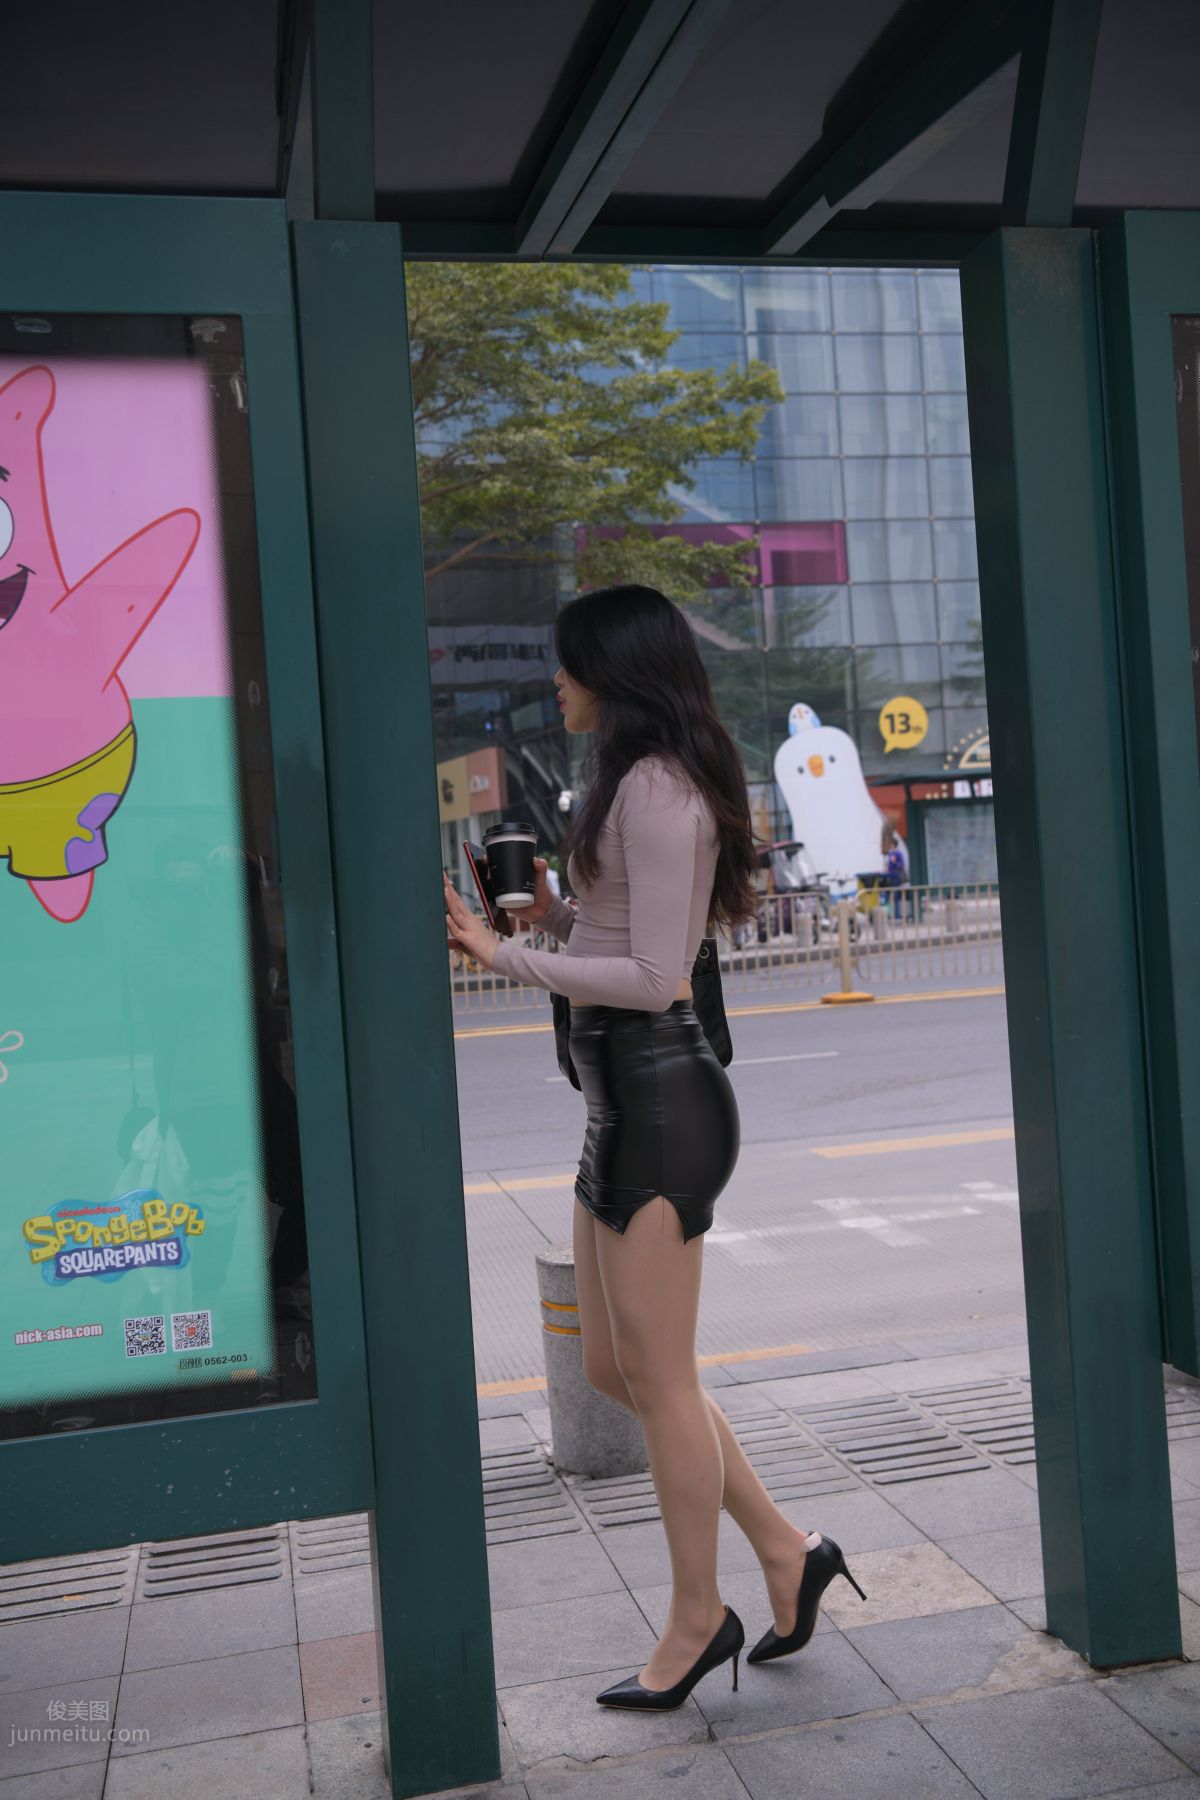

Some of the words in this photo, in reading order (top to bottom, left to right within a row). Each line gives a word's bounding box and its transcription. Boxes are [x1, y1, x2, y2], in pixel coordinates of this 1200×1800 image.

[57, 1205, 121, 1218] nickelodeon
[60, 1242, 179, 1274] SQUAREPANTS
[15, 1323, 103, 1345] nick-asia.com
[204, 1354, 248, 1366] 0562-003
